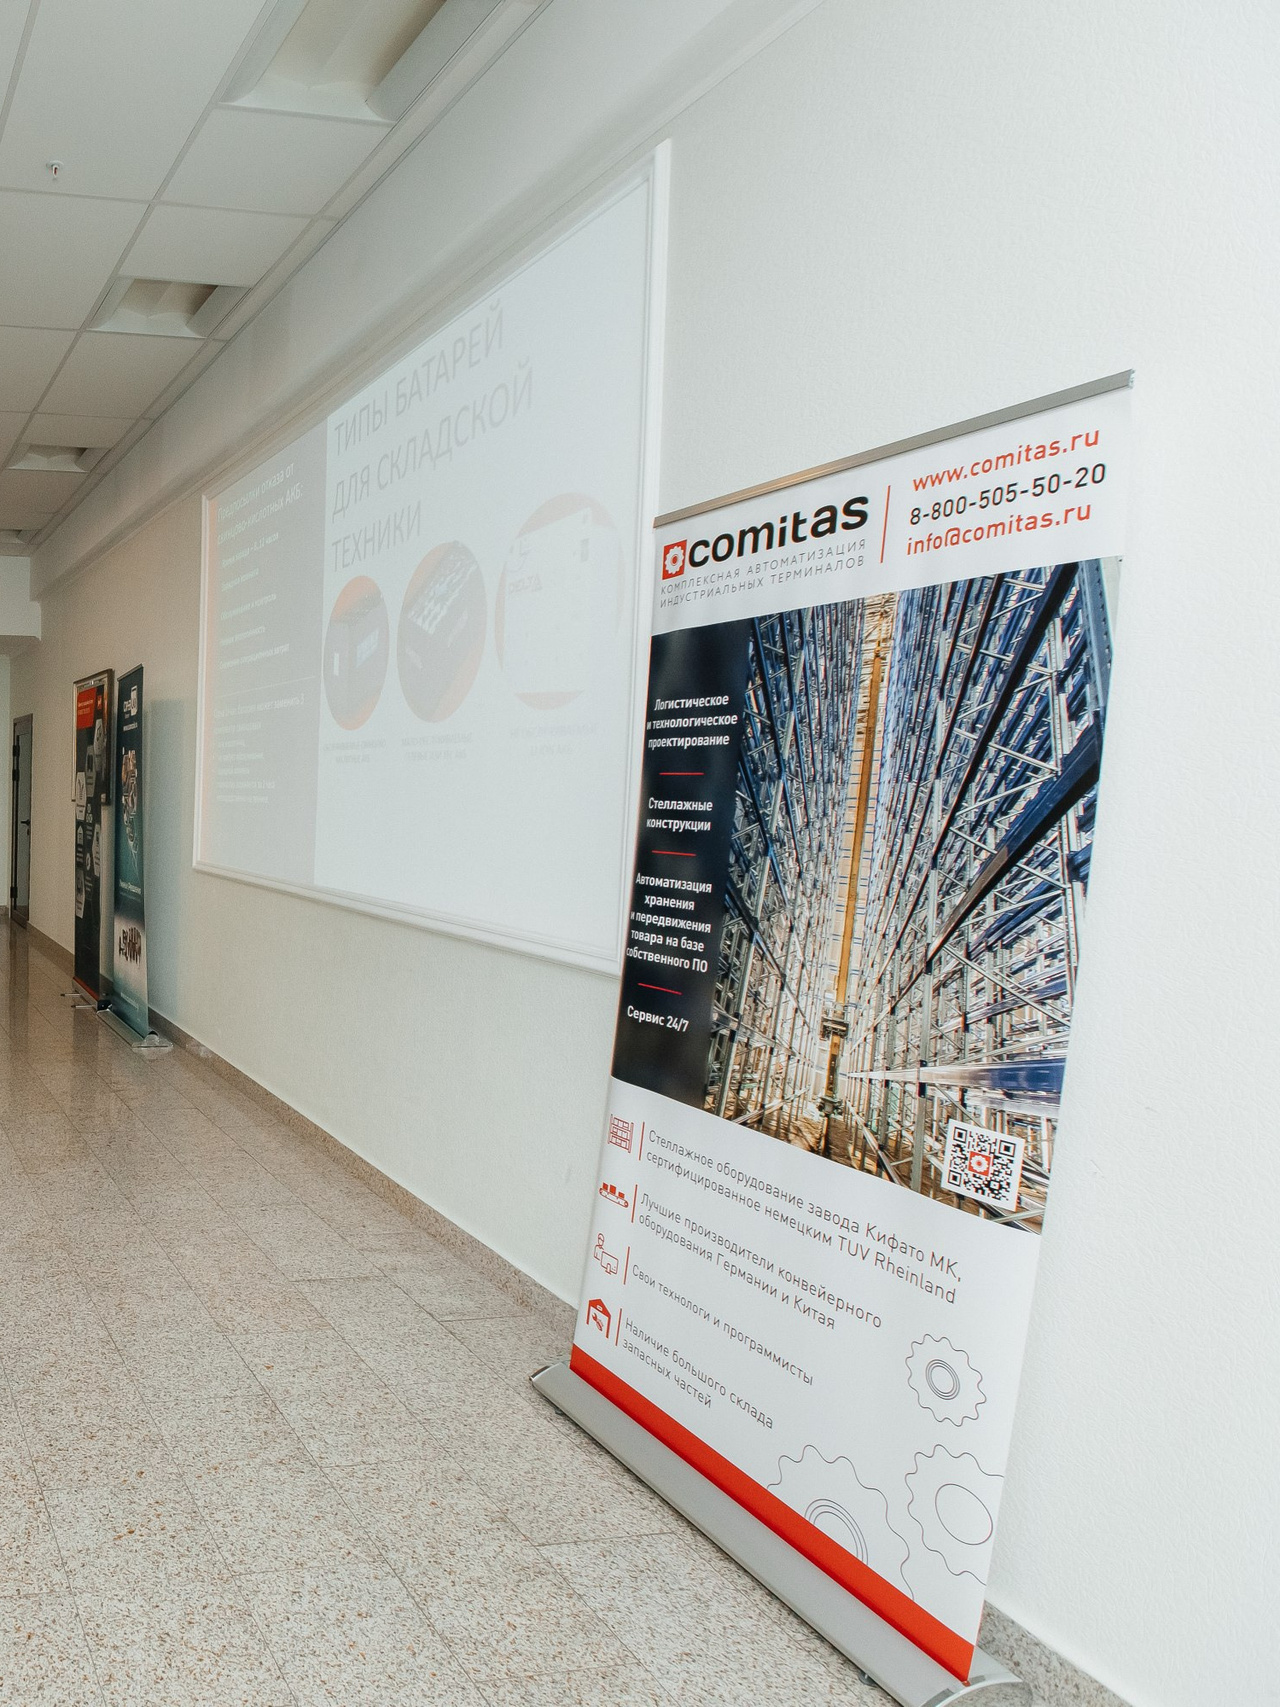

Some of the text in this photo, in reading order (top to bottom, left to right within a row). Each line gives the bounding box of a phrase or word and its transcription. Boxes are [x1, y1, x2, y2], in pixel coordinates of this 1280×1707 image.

[334, 297, 505, 456] ТИПЫ БАТАРЕЙ
[332, 356, 534, 524] ДЛЯ СКЛАДСКОЙ
[913, 429, 1100, 492] www.comitas.ru
[261, 470, 284, 494] отказа
[285, 463, 294, 478] от
[285, 482, 303, 505] АКБ:
[910, 463, 1106, 525] 8-800-505-50-20
[332, 499, 422, 573] ТЕХНИКИ
[688, 496, 869, 568] comitas
[906, 504, 1092, 556] info@comitas.ru
[660, 539, 866, 595] КОМПЛЕКСНАЯ АВТОМАТИЗАЦИЯ
[660, 555, 865, 608] ИНДУСТРИАЛЬНЫХ ТЕРМИНАЛОВ
[647, 714, 738, 730] и технологическое
[654, 695, 729, 711] Логистическое
[648, 735, 730, 751] проектирование
[646, 818, 711, 833] конструкции
[648, 797, 713, 812] Стеллажные
[635, 873, 712, 894] Автоматизация
[644, 895, 695, 911] хранения
[630, 911, 711, 933] и передвижения
[631, 930, 704, 952] товара на базе
[626, 946, 708, 973] собственного ПО
[627, 1005, 689, 1033] Сервис 24/7
[647, 1151, 956, 1304] сертифицированное немецким TUV Rheinland
[649, 1130, 961, 1282] Стеллажное оборудование завода Кифато МК,
[639, 1214, 835, 1329] оборудования Германии и Китая
[641, 1193, 881, 1328] Лучшие производители конвейерного
[632, 1264, 814, 1386] Свои технологи и программисты
[623, 1338, 712, 1408] запасных частей
[625, 1317, 773, 1429] Наличие большого склада
